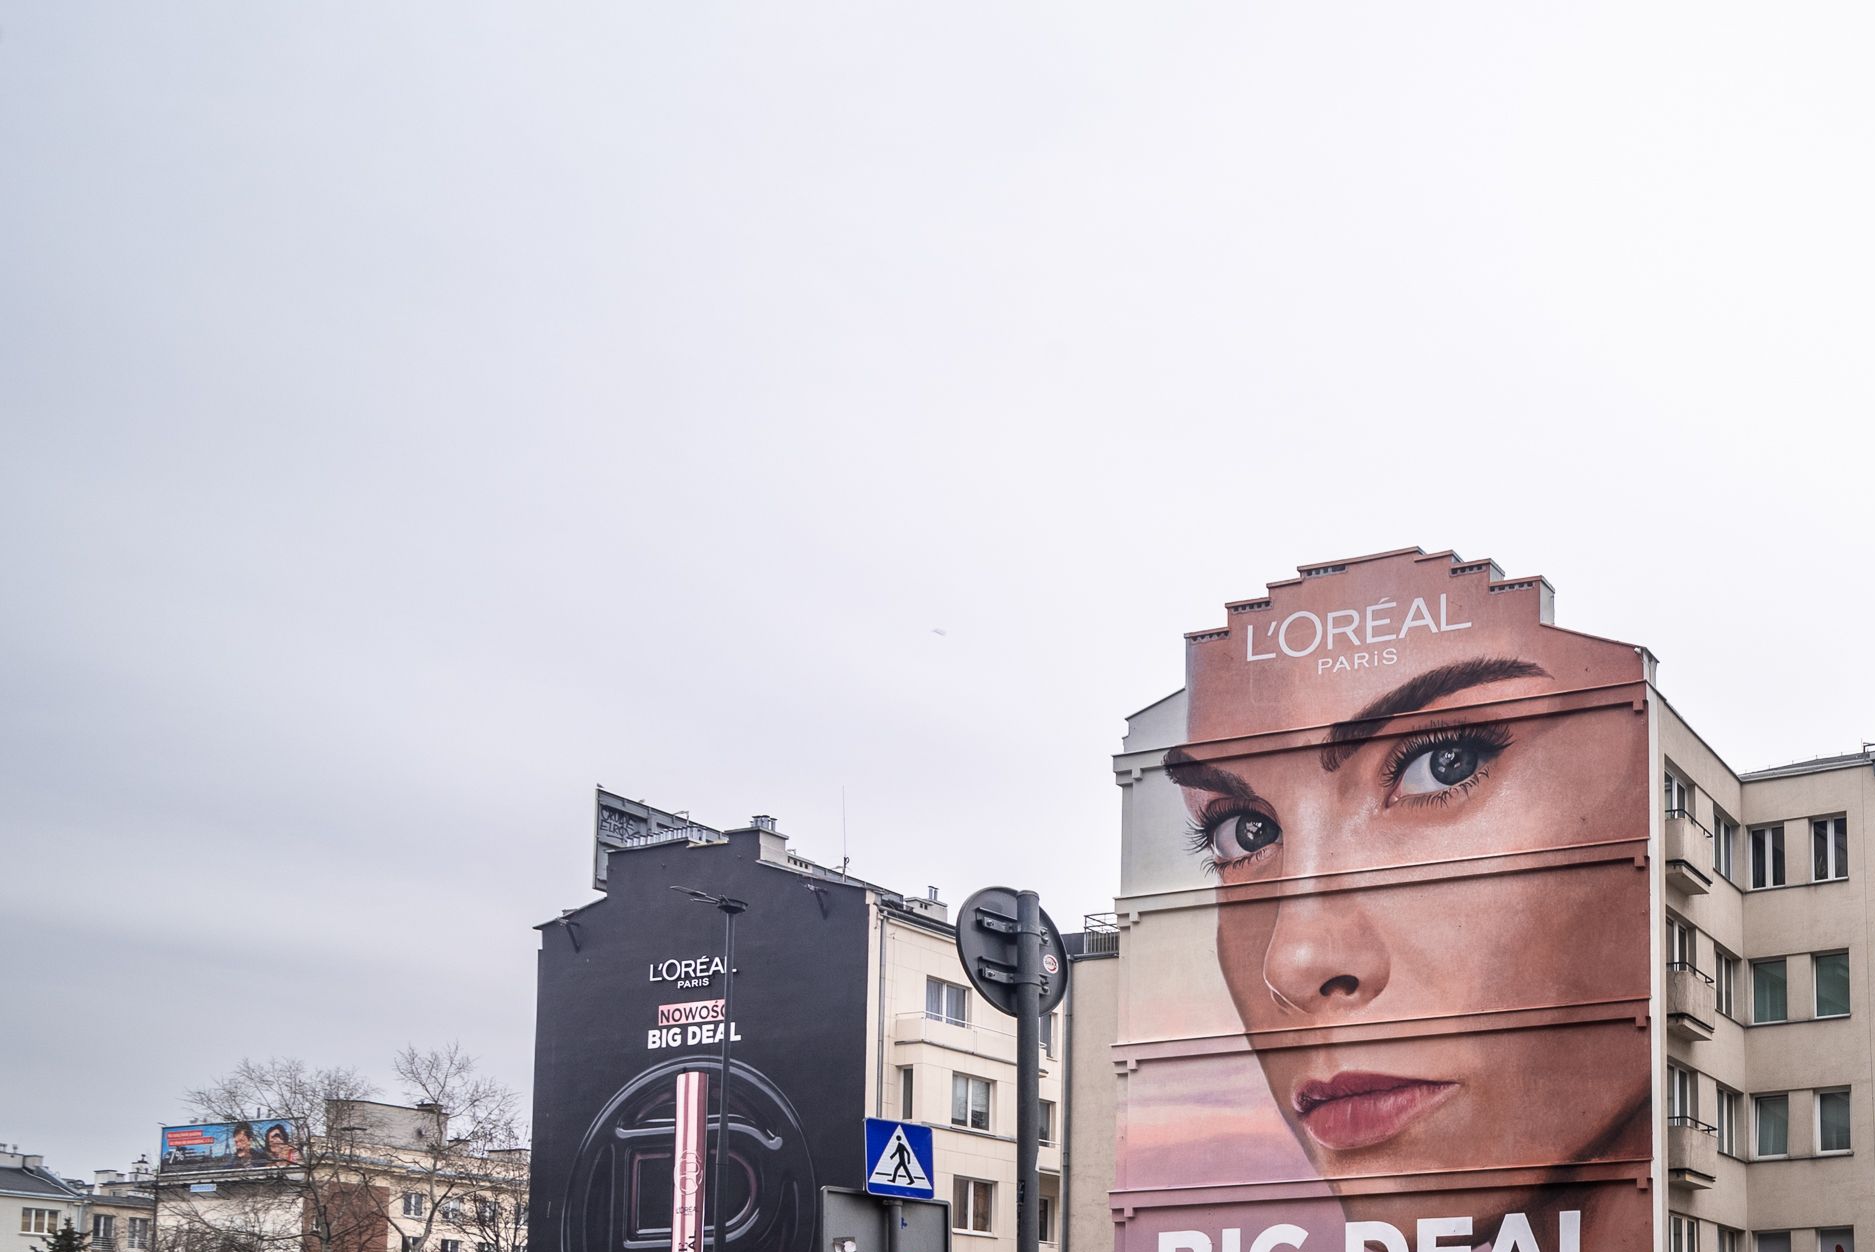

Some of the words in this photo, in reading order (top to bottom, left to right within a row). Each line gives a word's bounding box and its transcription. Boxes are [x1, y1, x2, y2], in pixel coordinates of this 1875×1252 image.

[1246, 593, 1473, 662] L'ORÉAL
[647, 1027, 682, 1050] BIG
[687, 1021, 742, 1046] DEAL
